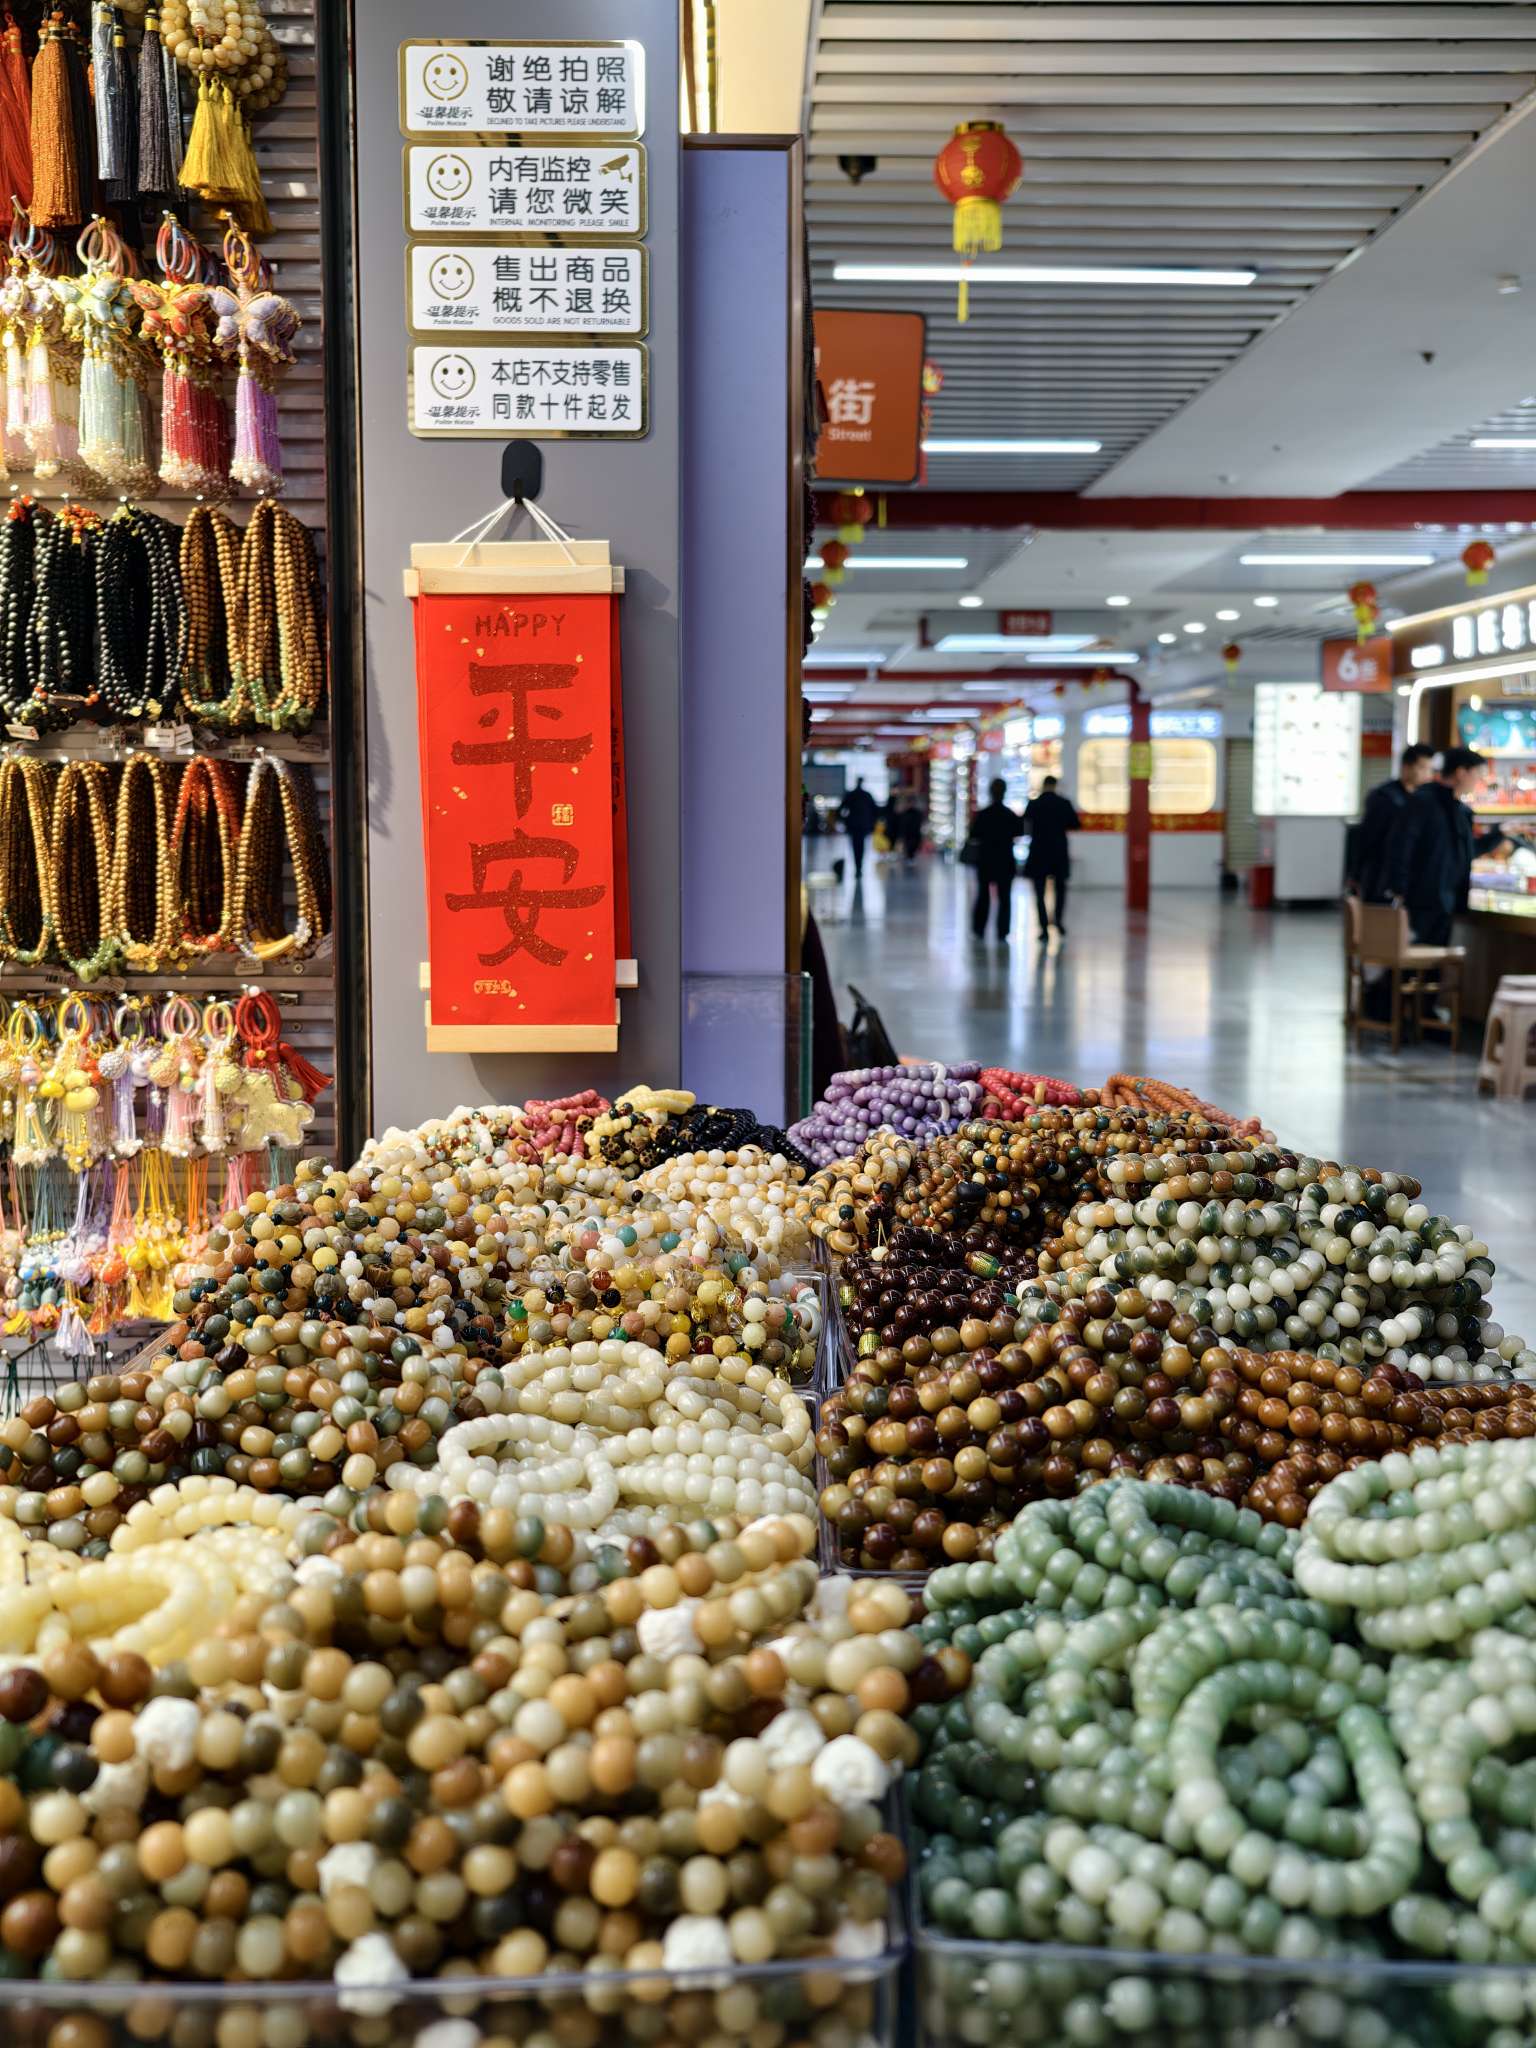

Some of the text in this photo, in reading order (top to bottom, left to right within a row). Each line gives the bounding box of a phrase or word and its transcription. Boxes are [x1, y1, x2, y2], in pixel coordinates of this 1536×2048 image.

[486, 55, 626, 83] 谢绝拍照
[417, 106, 473, 119] 温馨提示
[486, 87, 626, 114] 敬请谅解
[487, 118, 626, 126] DECLINED TO TAKE PICTURES PLEASE UNDERSTAND
[489, 156, 591, 183] 内有监控
[421, 206, 477, 219] 温馨提示
[489, 188, 629, 215] 请您微笑
[489, 218, 629, 227] INTERNAL MONITORING PLEASE SMILE
[492, 255, 630, 283] 售出商品
[423, 305, 480, 317] 温馨提示
[492, 287, 631, 314] 概不退换
[493, 317, 631, 326] GOODS SOLD ARE NOT RETURNABLE
[491, 359, 631, 387] 本店不支持零售
[424, 405, 481, 418] 温馨提示
[492, 393, 631, 421] 同款十件起发
[828, 378, 876, 425] 街
[828, 428, 872, 442] Street
[475, 612, 566, 637] HAPPY
[445, 662, 606, 967] 平安
